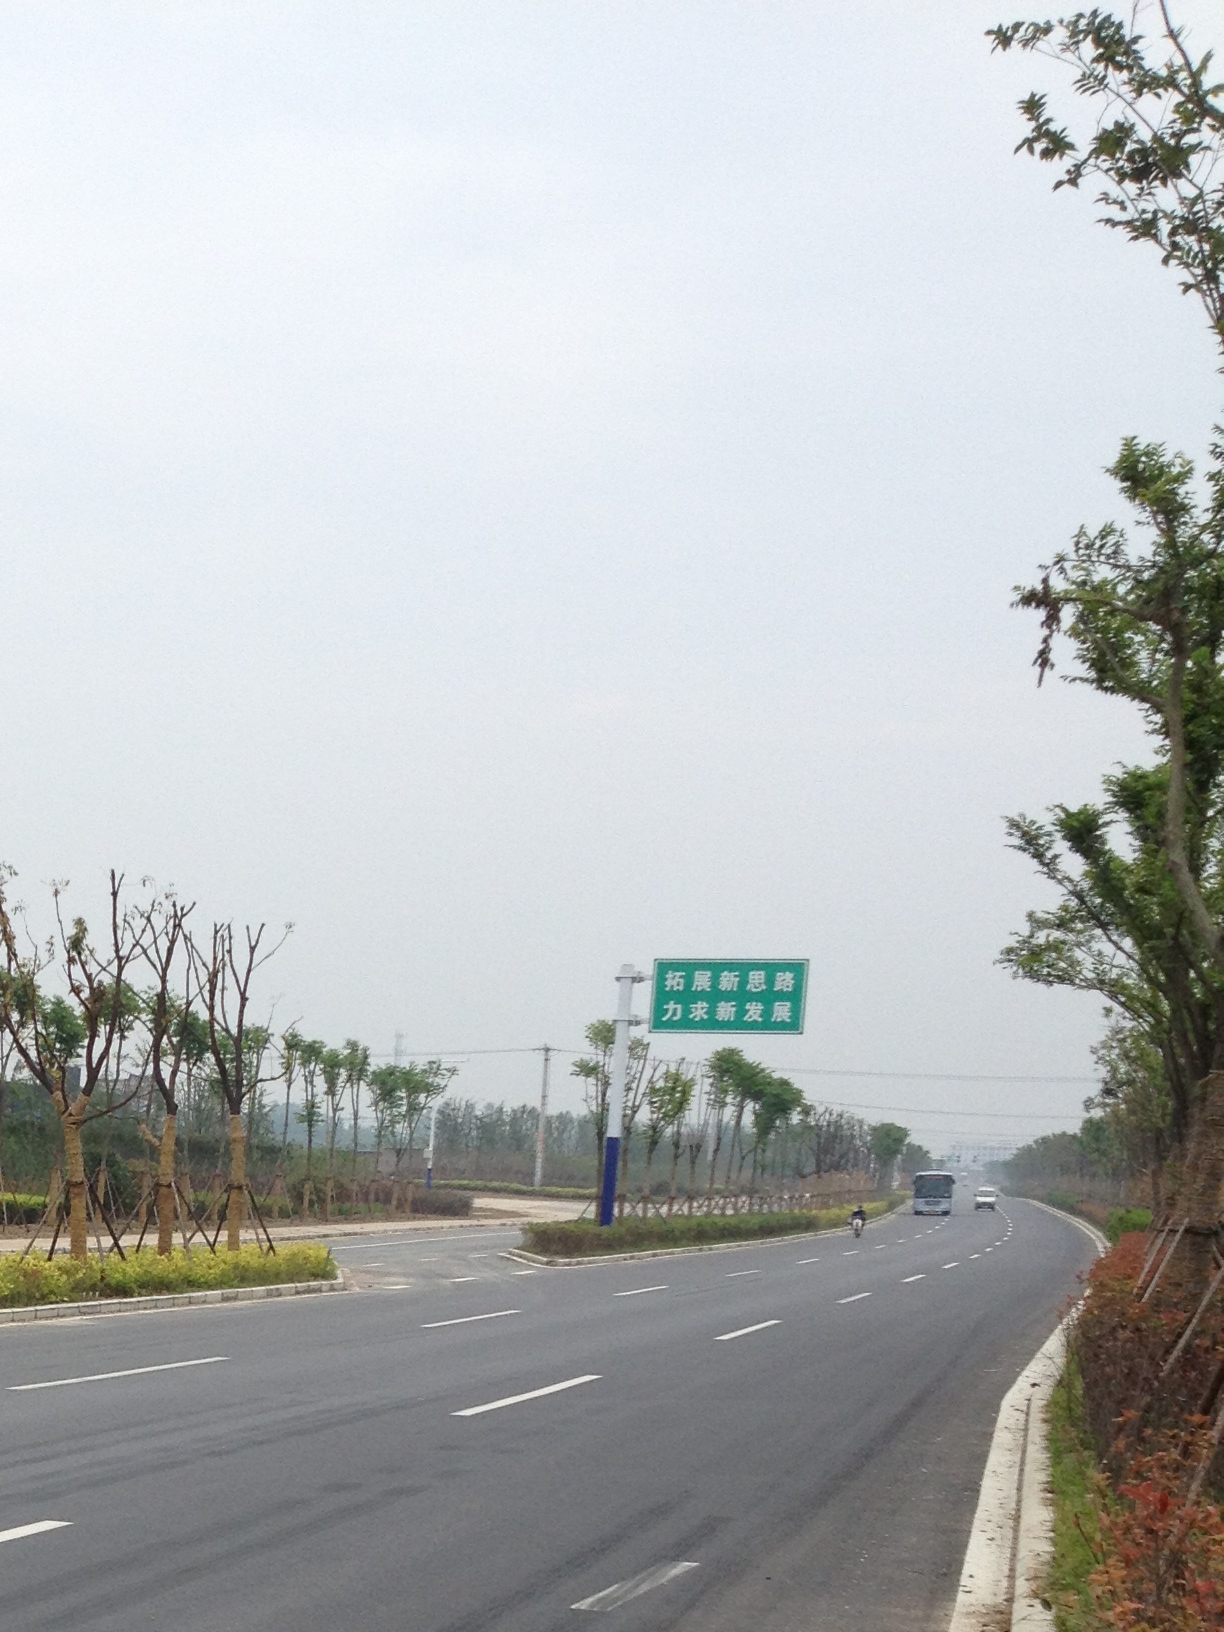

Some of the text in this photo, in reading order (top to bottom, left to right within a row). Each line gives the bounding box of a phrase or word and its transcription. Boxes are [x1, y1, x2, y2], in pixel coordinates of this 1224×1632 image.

[665, 970, 795, 992] 拓展新思路
[662, 1001, 792, 1023] 力求新发展
